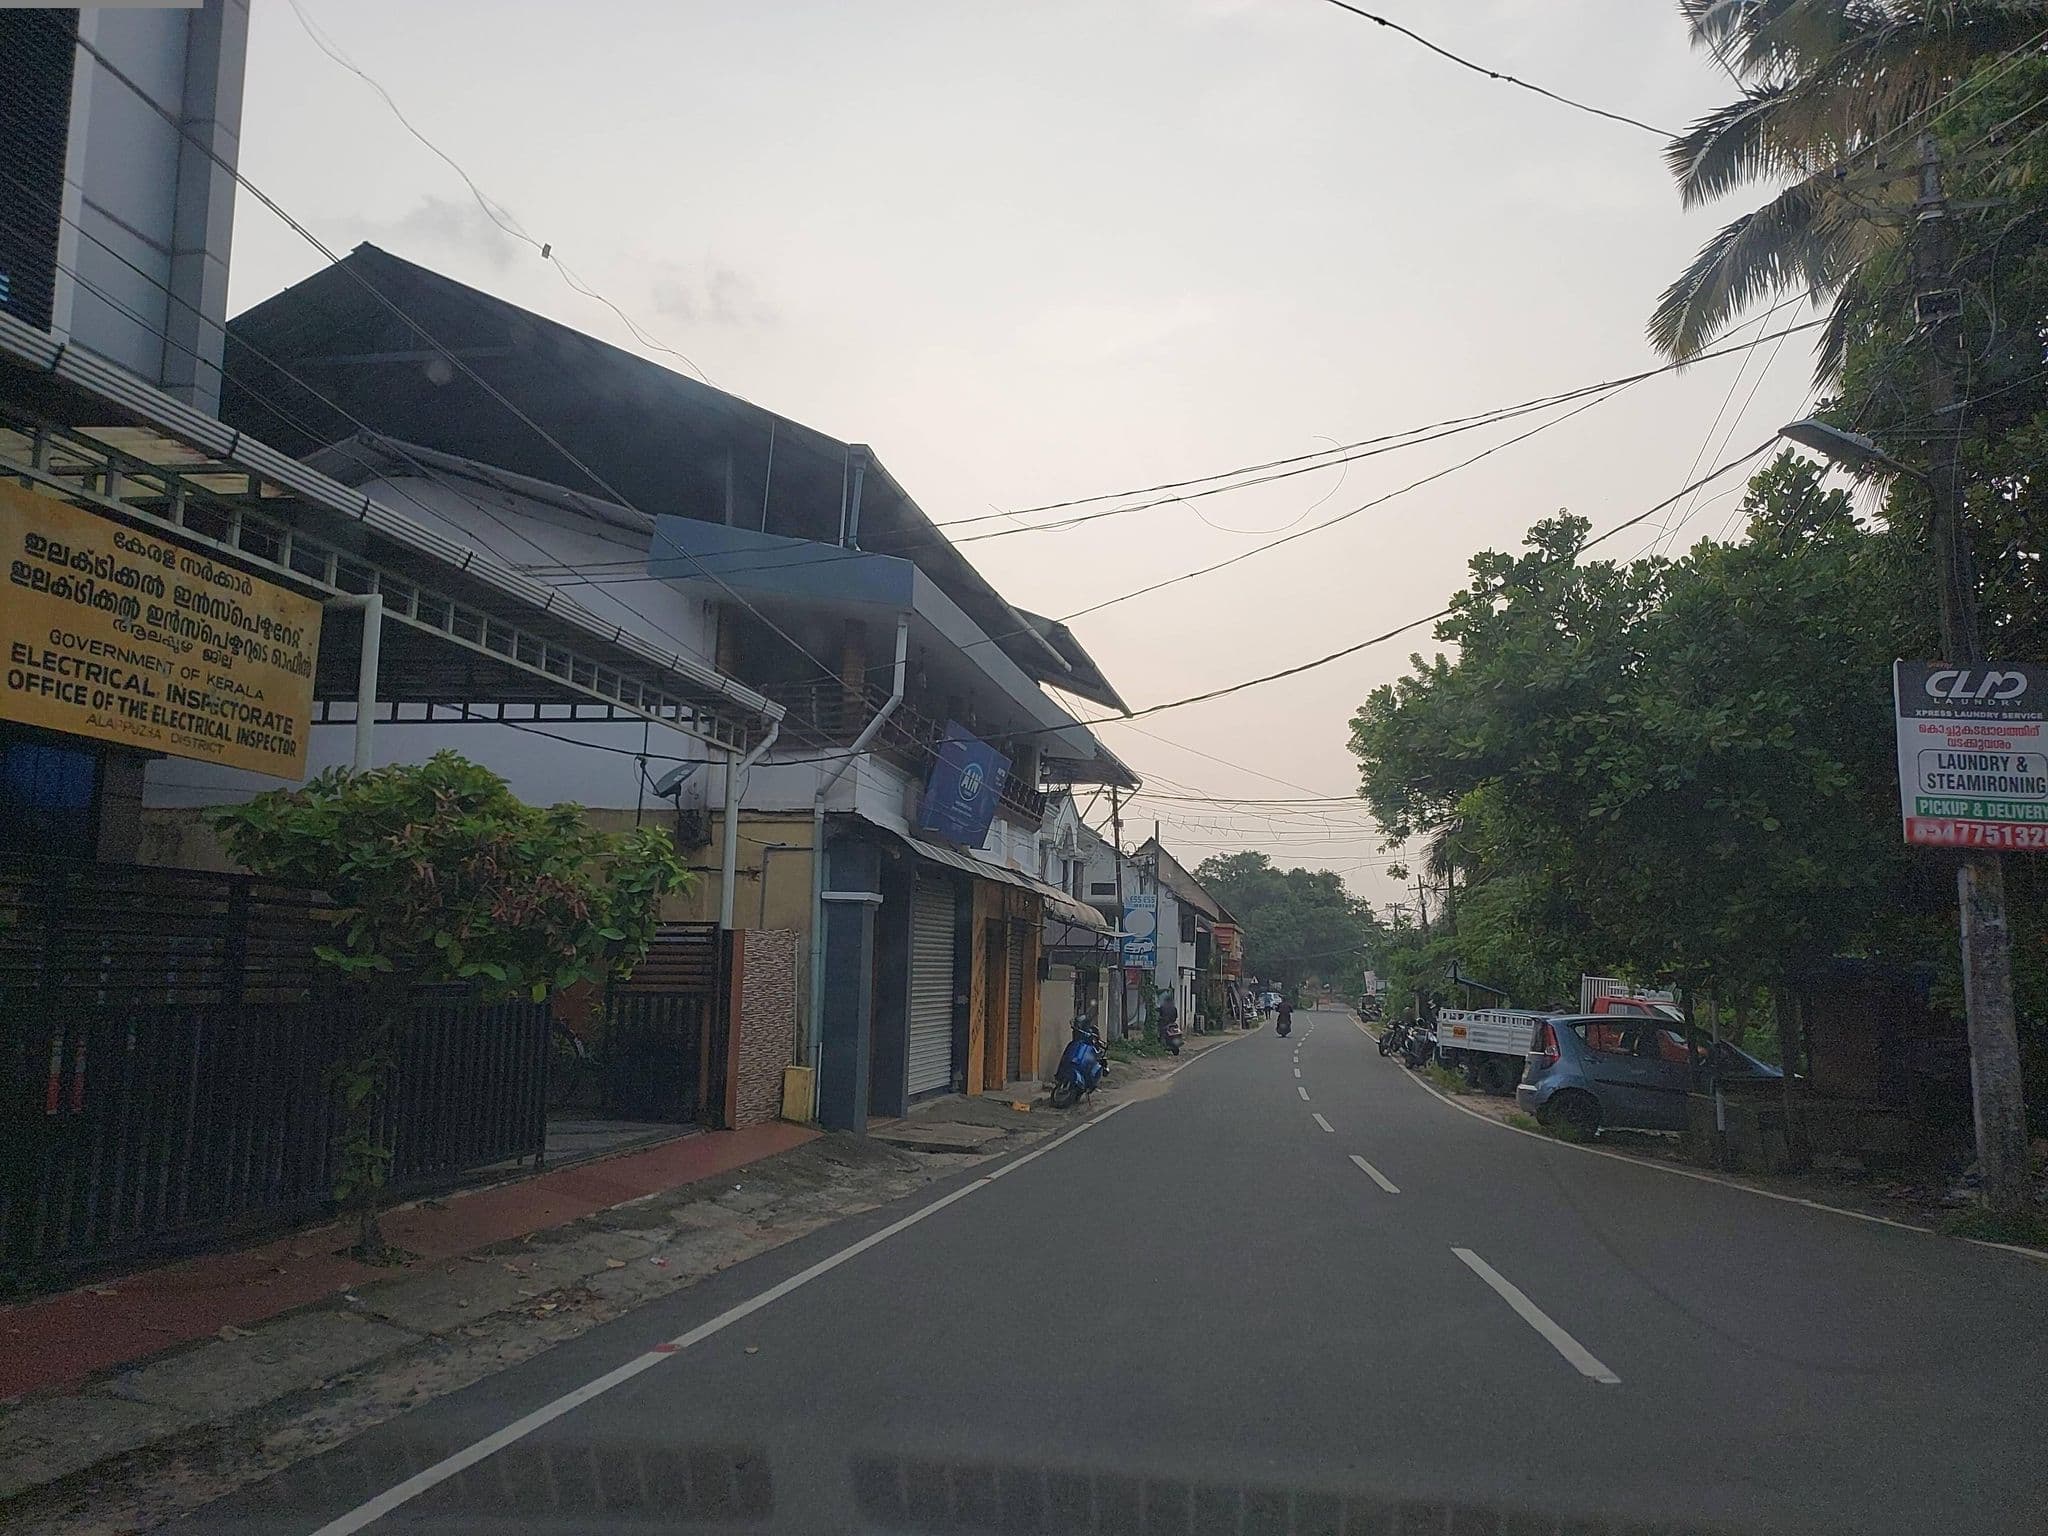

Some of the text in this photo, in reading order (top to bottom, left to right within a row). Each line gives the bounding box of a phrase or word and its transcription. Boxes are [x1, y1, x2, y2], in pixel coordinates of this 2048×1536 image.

[49, 628, 265, 701] GOVERNMENT OF KERALA
[11, 642, 294, 736] ELECTRICAL INSPECTORATE
[1934, 698, 2023, 706] LAUNDRY
[8, 669, 297, 758] OFFICE OF THE ELECTRICAL INSPECTOR
[1915, 709, 2043, 720] XPRESS LAUNDRY SERVICE
[171, 731, 226, 755] DISTRICT
[1938, 753, 2028, 773] LAUNDRY &
[1927, 773, 2046, 794] STEAMIRONING
[1920, 799, 2048, 820] PICKUP & DELIVERY
